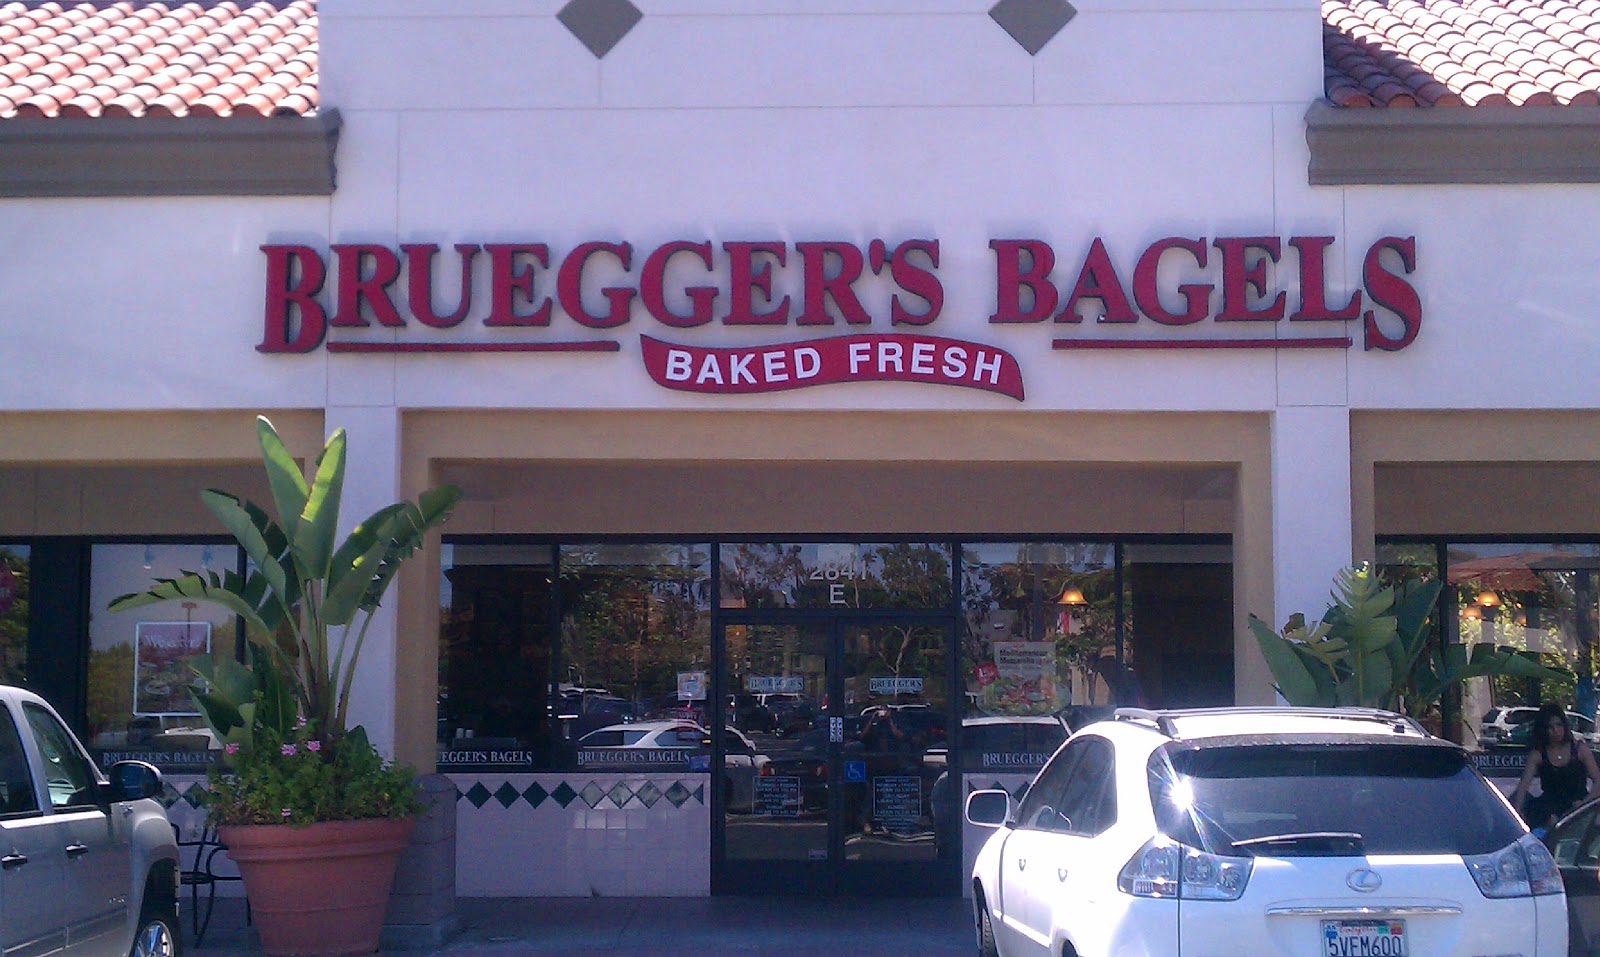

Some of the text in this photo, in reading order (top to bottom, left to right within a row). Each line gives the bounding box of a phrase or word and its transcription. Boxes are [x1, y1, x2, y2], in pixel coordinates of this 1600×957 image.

[255, 236, 1422, 353] BRUEGGER'S BAGELS
[665, 341, 1003, 386] BAKED FRESH
[830, 584, 845, 604] E
[436, 751, 533, 765] UEGGER'S BAGELS
[577, 751, 690, 765] BRUEGGER'S BAGELS
[1471, 754, 1527, 769] BRUEGGE
